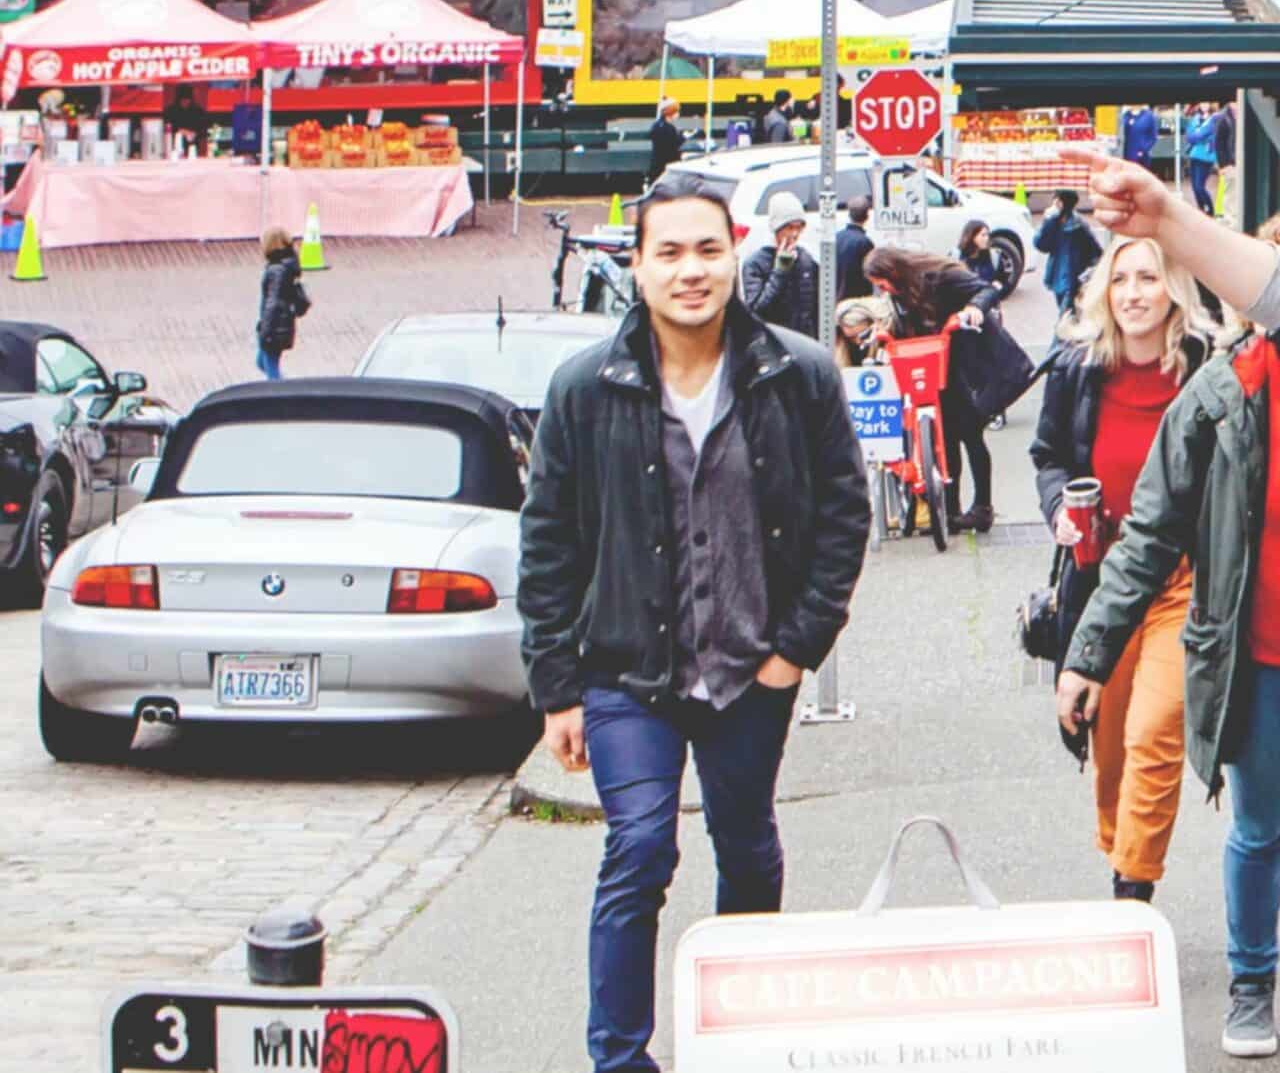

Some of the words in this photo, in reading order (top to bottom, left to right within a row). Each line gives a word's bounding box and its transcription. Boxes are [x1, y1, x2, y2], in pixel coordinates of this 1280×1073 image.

[108, 45, 201, 61] ORGANIC
[297, 43, 376, 66] TINY'S
[379, 41, 500, 64] ORGANIC
[73, 62, 115, 80] HOT
[119, 60, 182, 78] APPLE
[187, 56, 249, 75] CIDER
[859, 95, 938, 131] STOP
[879, 404, 898, 418] to
[854, 420, 891, 435] Park
[856, 951, 1137, 1003] CAMPAGNE
[153, 1005, 190, 1063] 3
